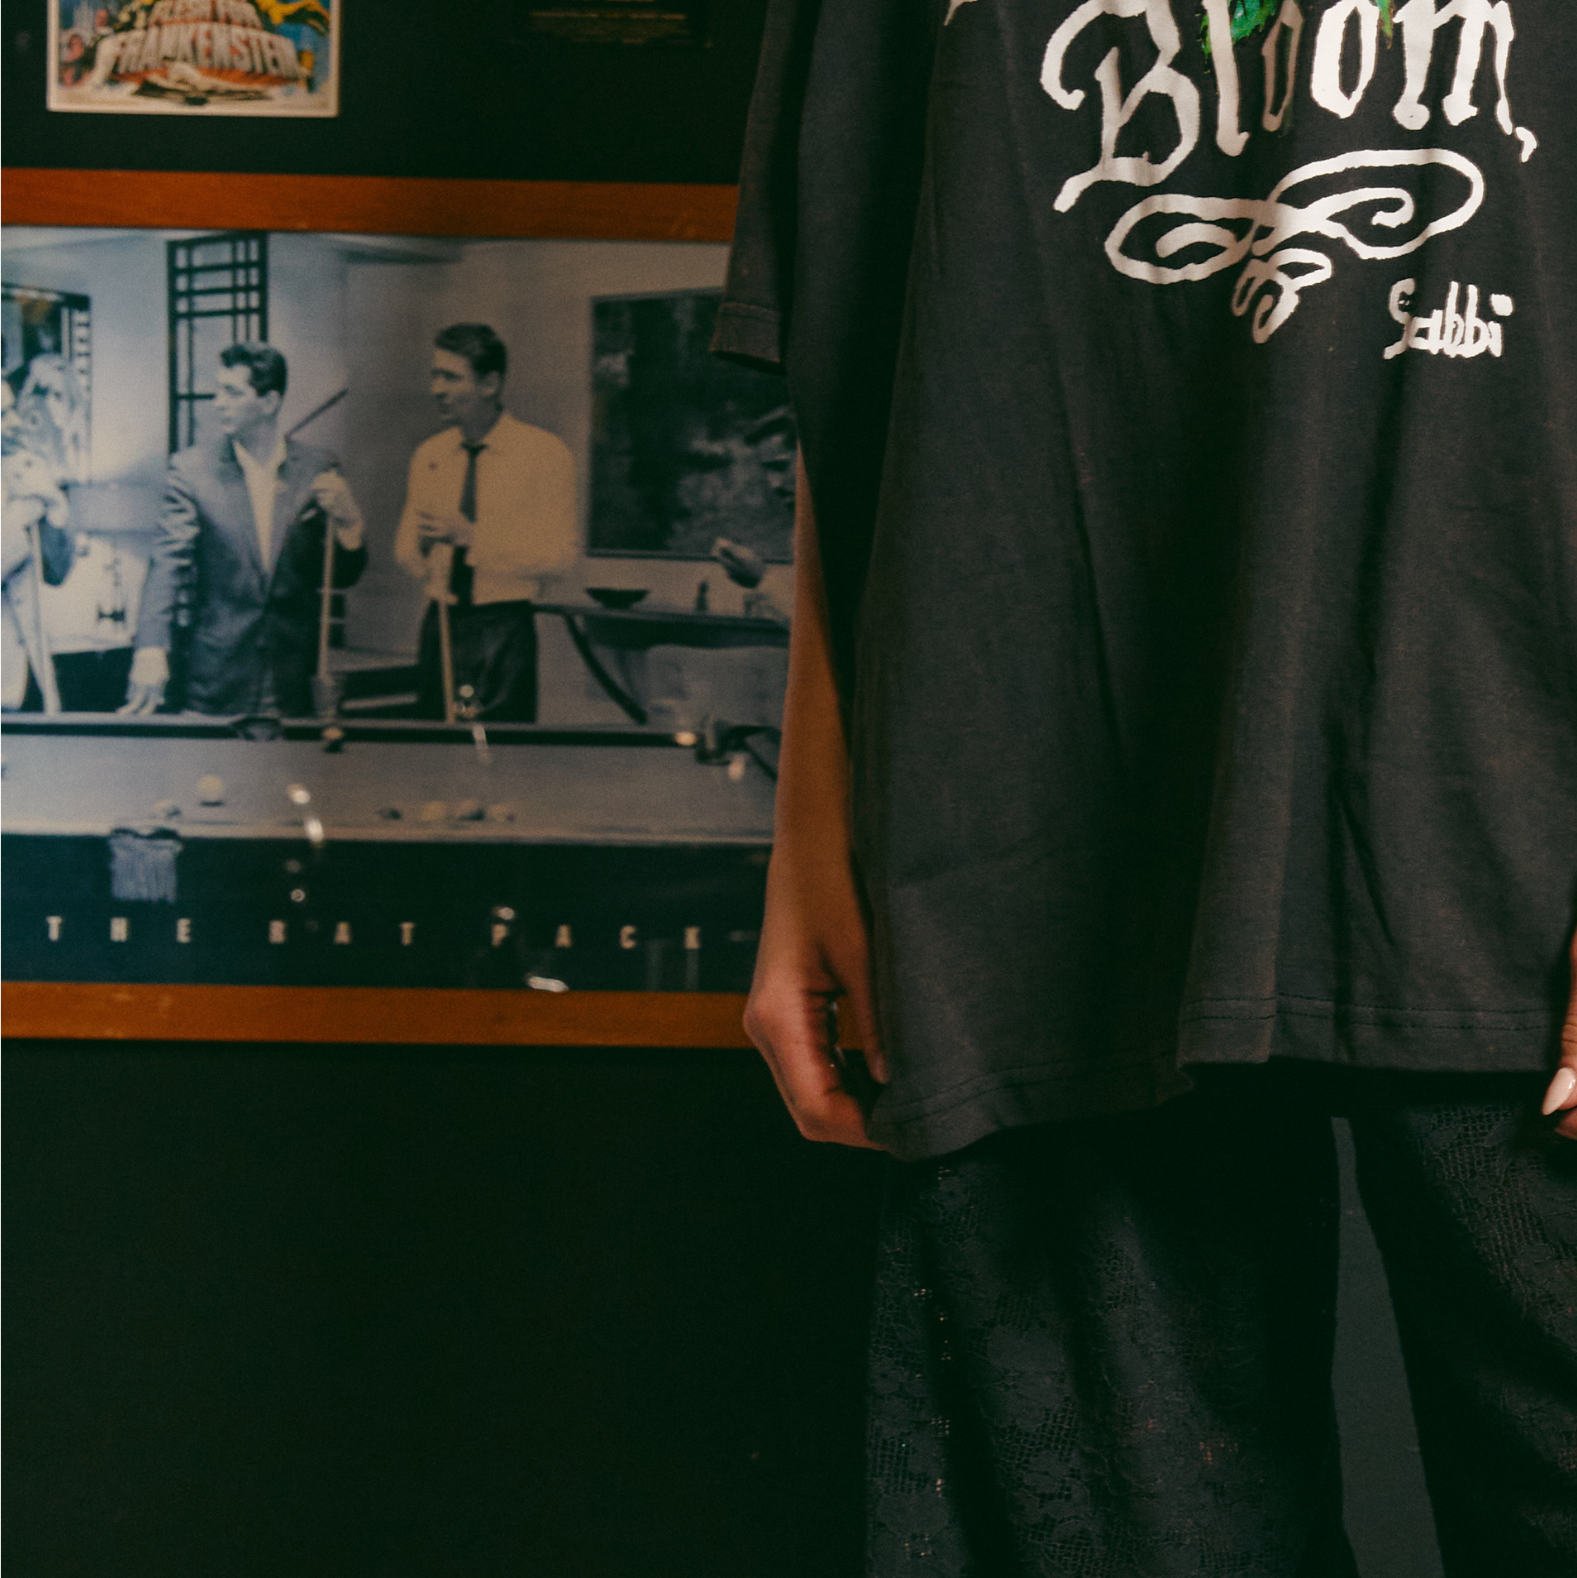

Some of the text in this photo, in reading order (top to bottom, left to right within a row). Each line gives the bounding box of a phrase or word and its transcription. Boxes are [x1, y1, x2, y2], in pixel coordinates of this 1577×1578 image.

[47, 915, 702, 951] THE RAT PACK
